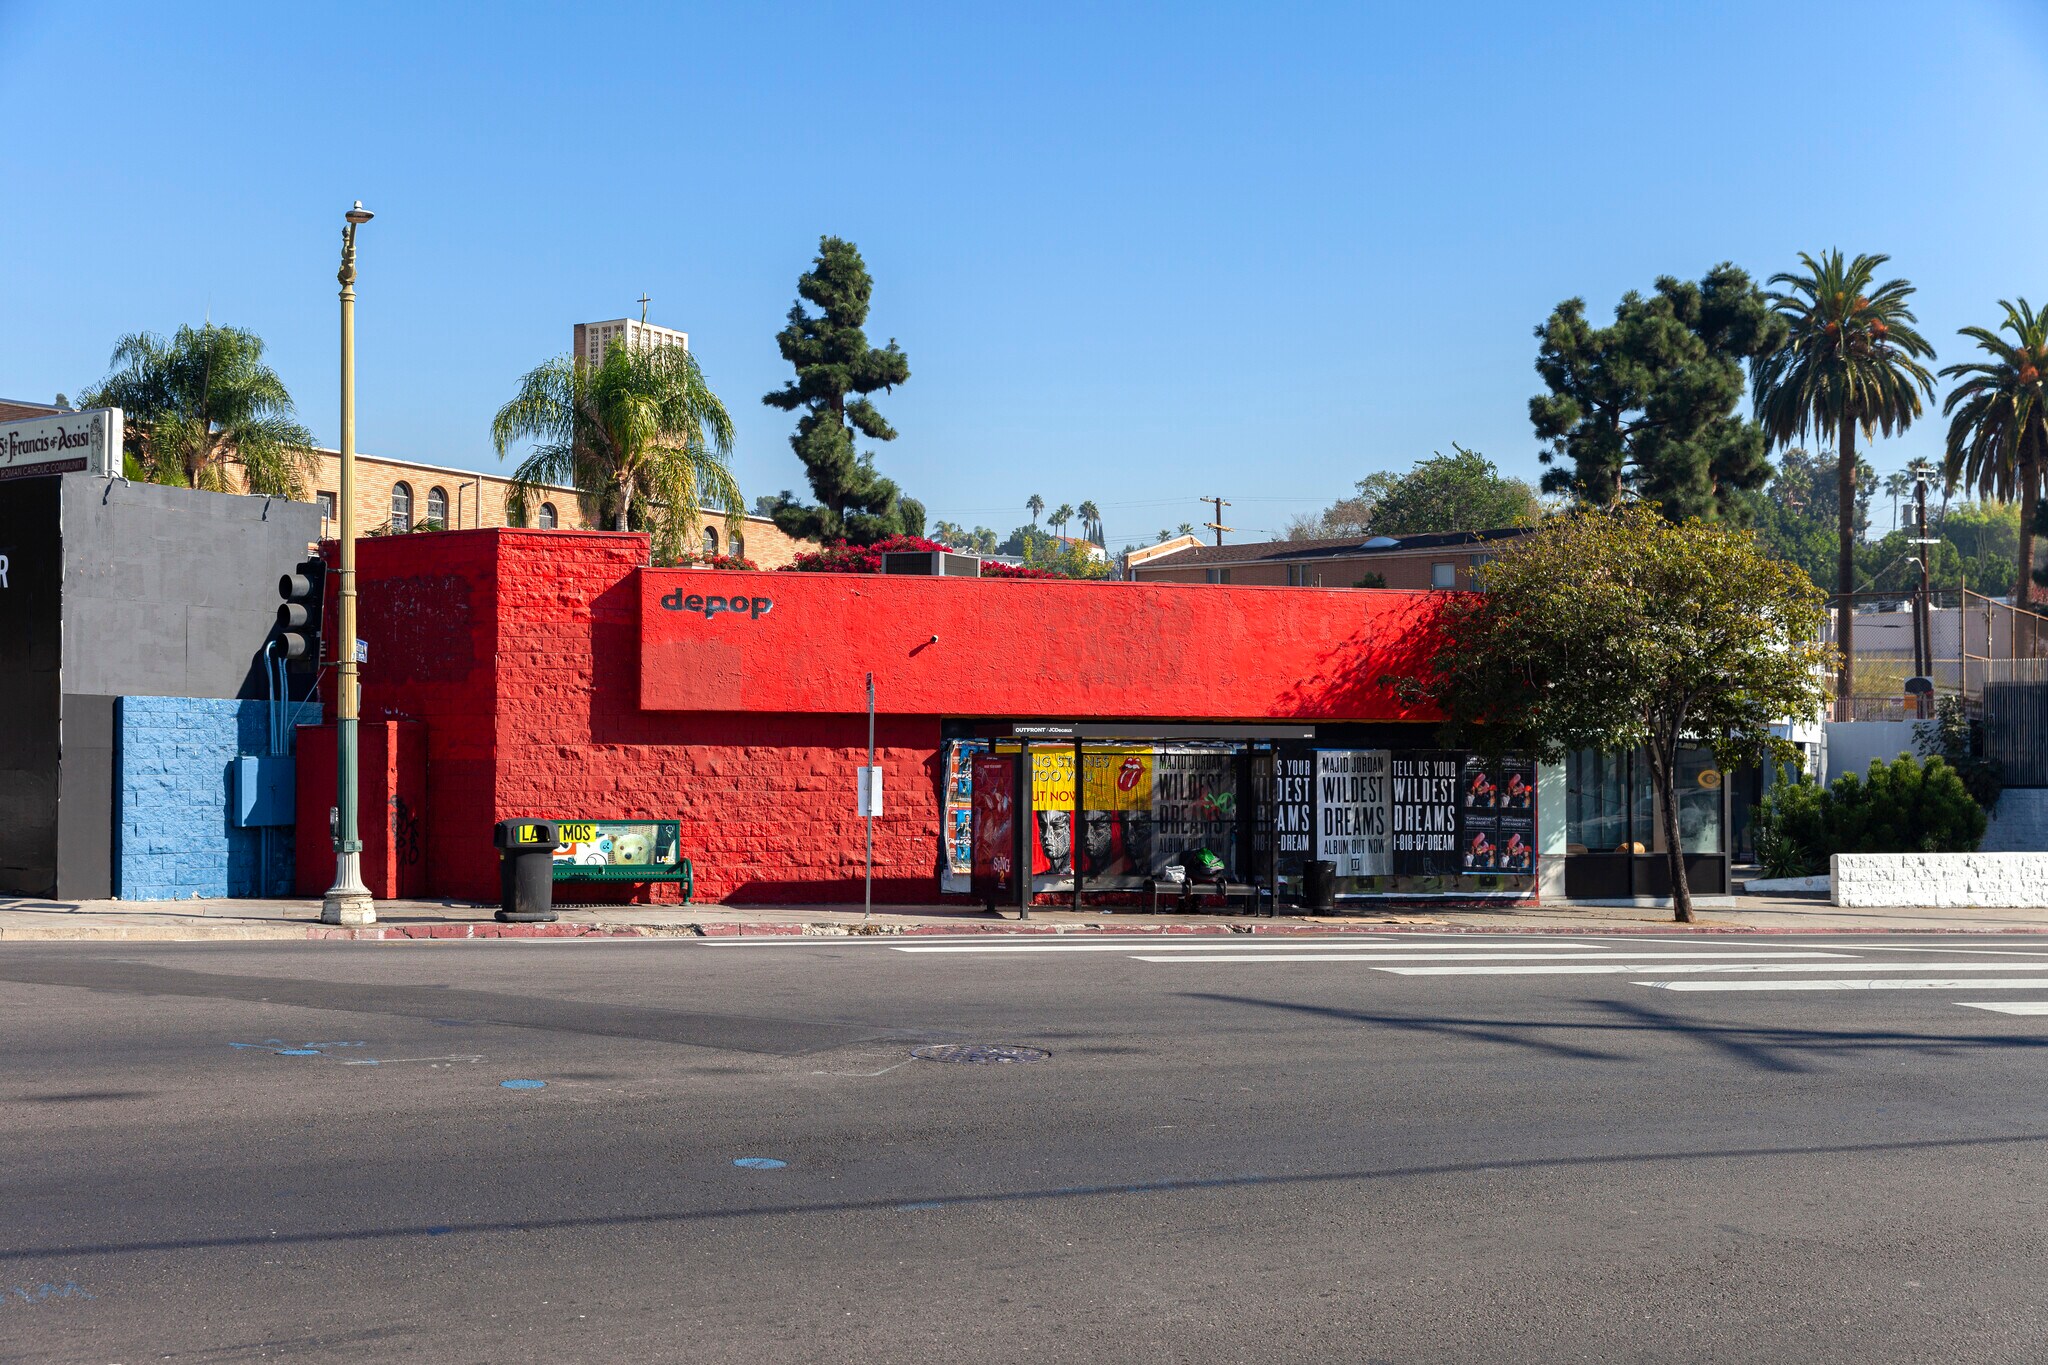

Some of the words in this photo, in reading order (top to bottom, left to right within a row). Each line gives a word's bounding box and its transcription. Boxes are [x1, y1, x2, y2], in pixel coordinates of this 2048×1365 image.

[7, 430, 49, 463] Francis
[57, 424, 89, 451] Assisi
[0, 467, 22, 478] ROMAN
[22, 463, 49, 475] CATHOLIC
[50, 460, 85, 472] COMMUNITY
[660, 588, 774, 620] depop
[1057, 756, 1110, 768] STNES
[1287, 760, 1311, 776] YOUR
[1322, 757, 1349, 774] MAJID
[1351, 757, 1384, 773] JORDAN
[1393, 760, 1414, 777] TELL
[1418, 760, 1430, 777] US
[1433, 761, 1456, 777] YOUR
[1066, 770, 1093, 782] YU
[1158, 773, 1223, 801] WILDEST
[1322, 776, 1384, 803] WILDEST
[1393, 778, 1456, 803] WILDEST
[1159, 804, 1224, 835] DREAMS
[1324, 807, 1385, 836] DREAMS
[1394, 804, 1456, 832] DREAMS
[1323, 839, 1349, 855] ALBUM
[1351, 839, 1365, 854] OUT
[1368, 838, 1385, 854] NOW
[1393, 834, 1455, 851] 1-818-87-DREAM
